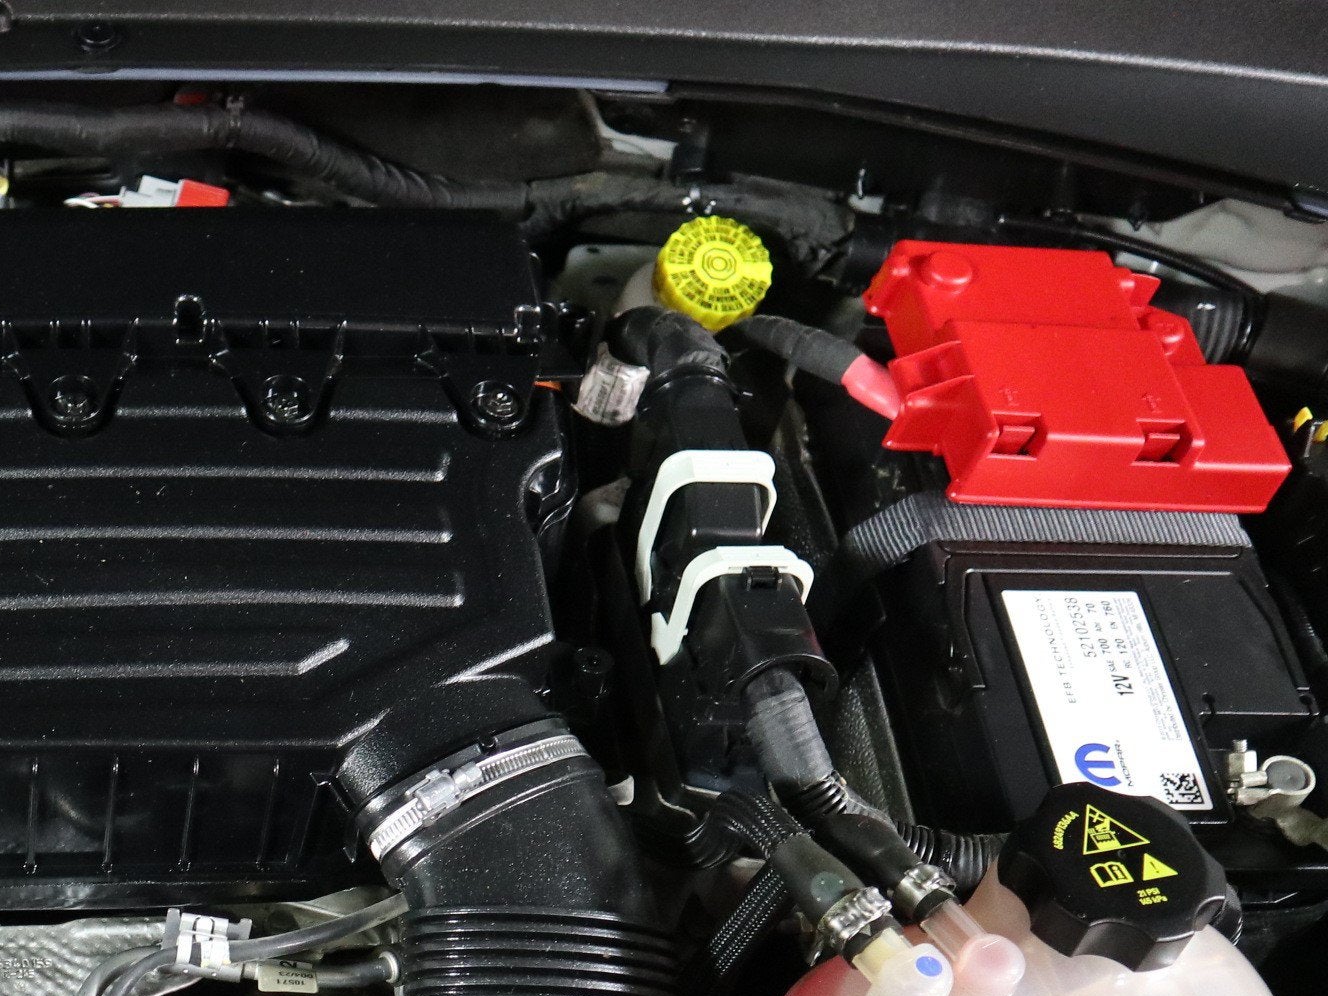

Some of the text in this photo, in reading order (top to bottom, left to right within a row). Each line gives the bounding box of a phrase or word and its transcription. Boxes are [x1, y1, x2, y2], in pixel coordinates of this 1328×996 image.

[1084, 602, 1097, 612] 70
[1065, 597, 1097, 657] 52102538
[1097, 638, 1111, 654] 700
[1113, 638, 1128, 654] 120
[1063, 683, 1077, 703] EFB
[1111, 675, 1134, 695] 12V
